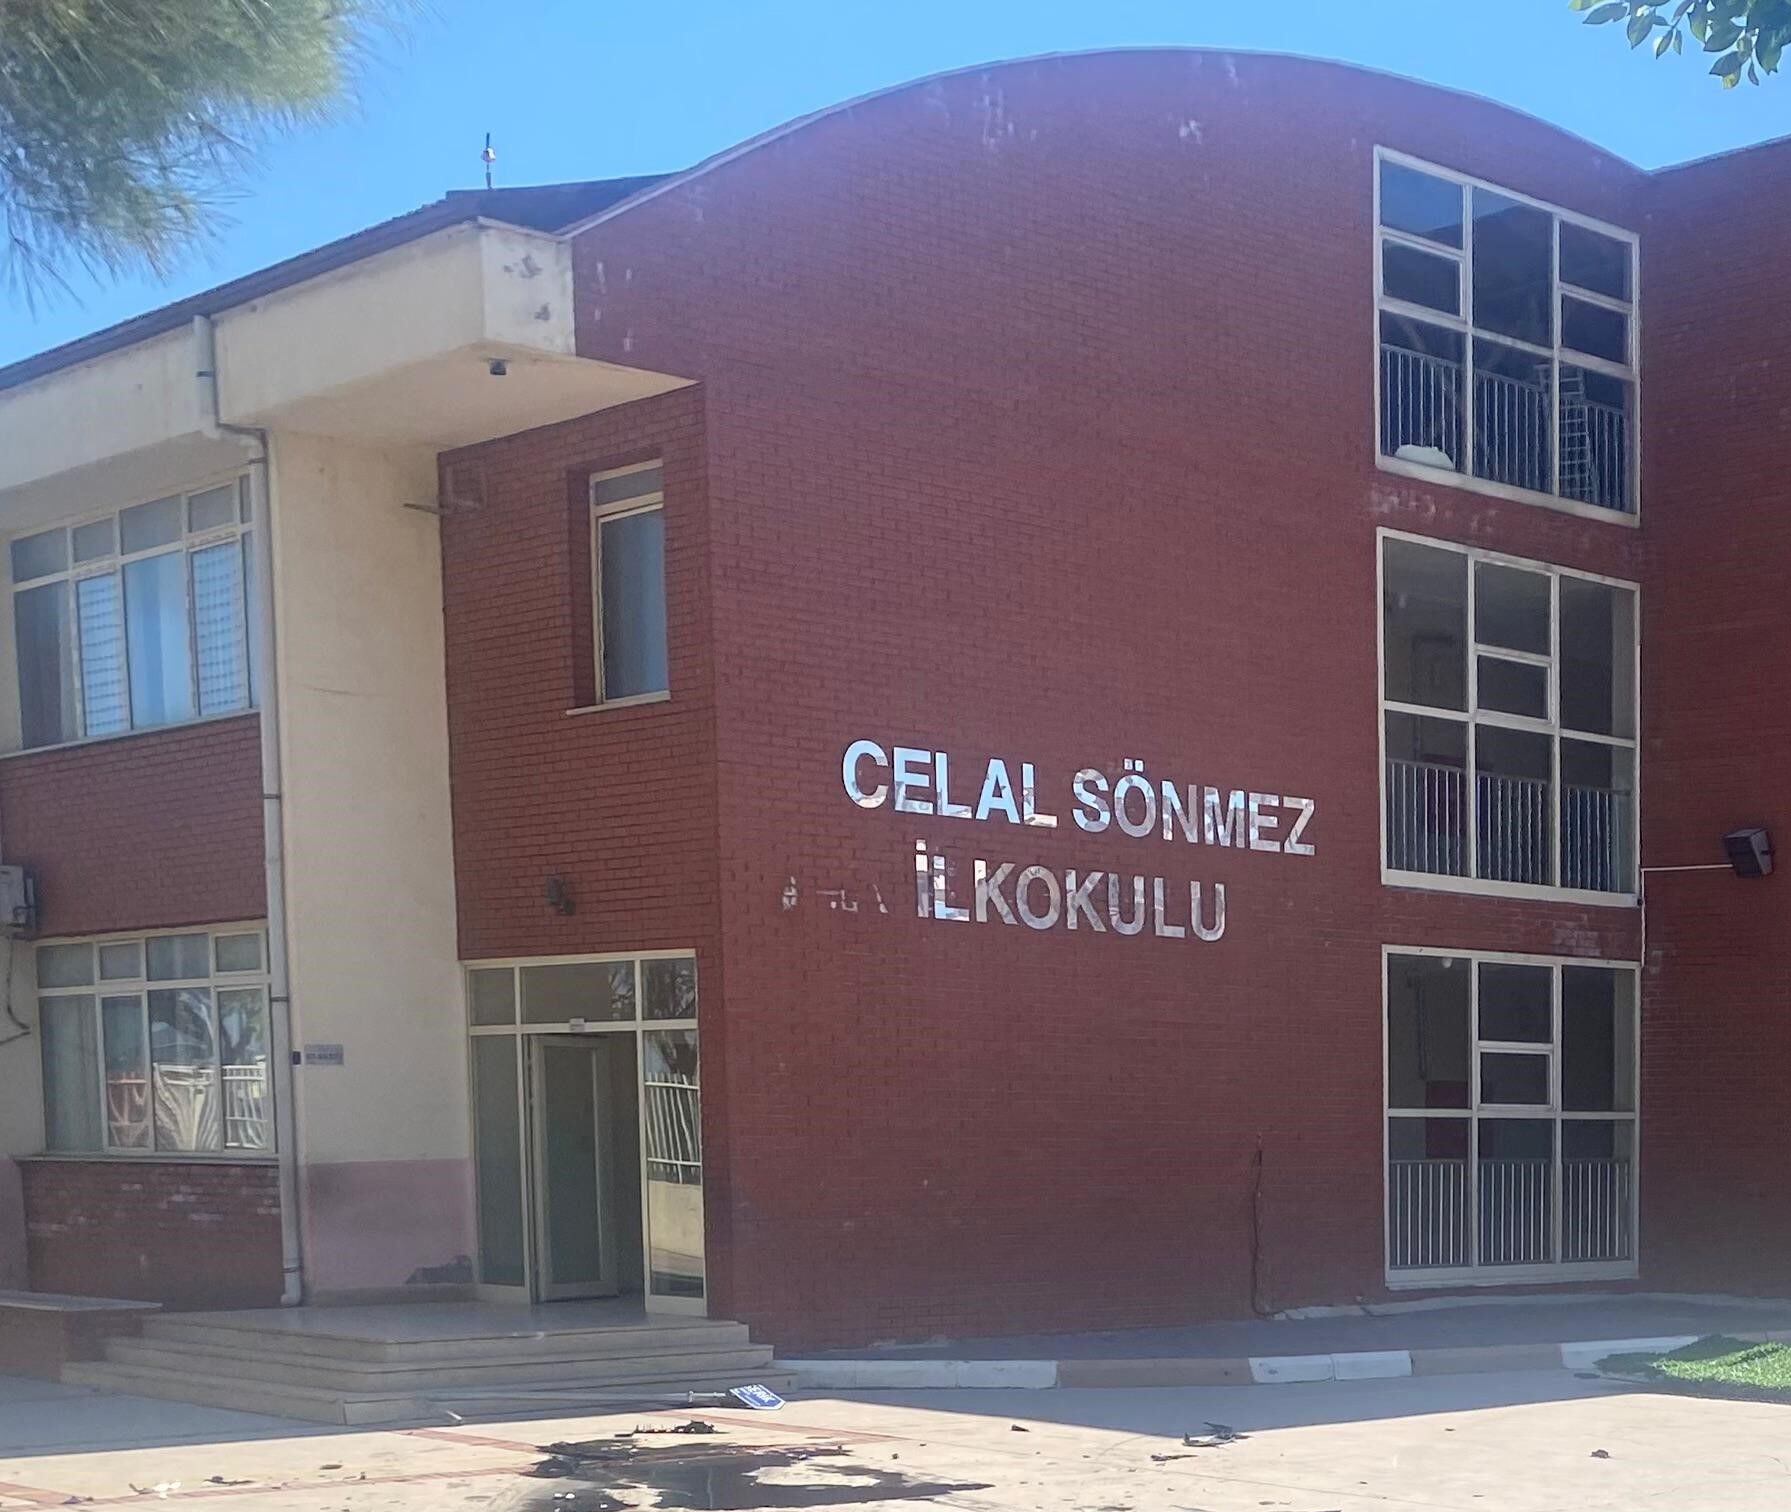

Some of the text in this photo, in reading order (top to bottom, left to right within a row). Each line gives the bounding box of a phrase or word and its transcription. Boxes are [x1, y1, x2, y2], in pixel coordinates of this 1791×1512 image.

[842, 739, 1315, 856] CELAL SÖNMEZ
[915, 839, 1226, 942] İLKOKULU
